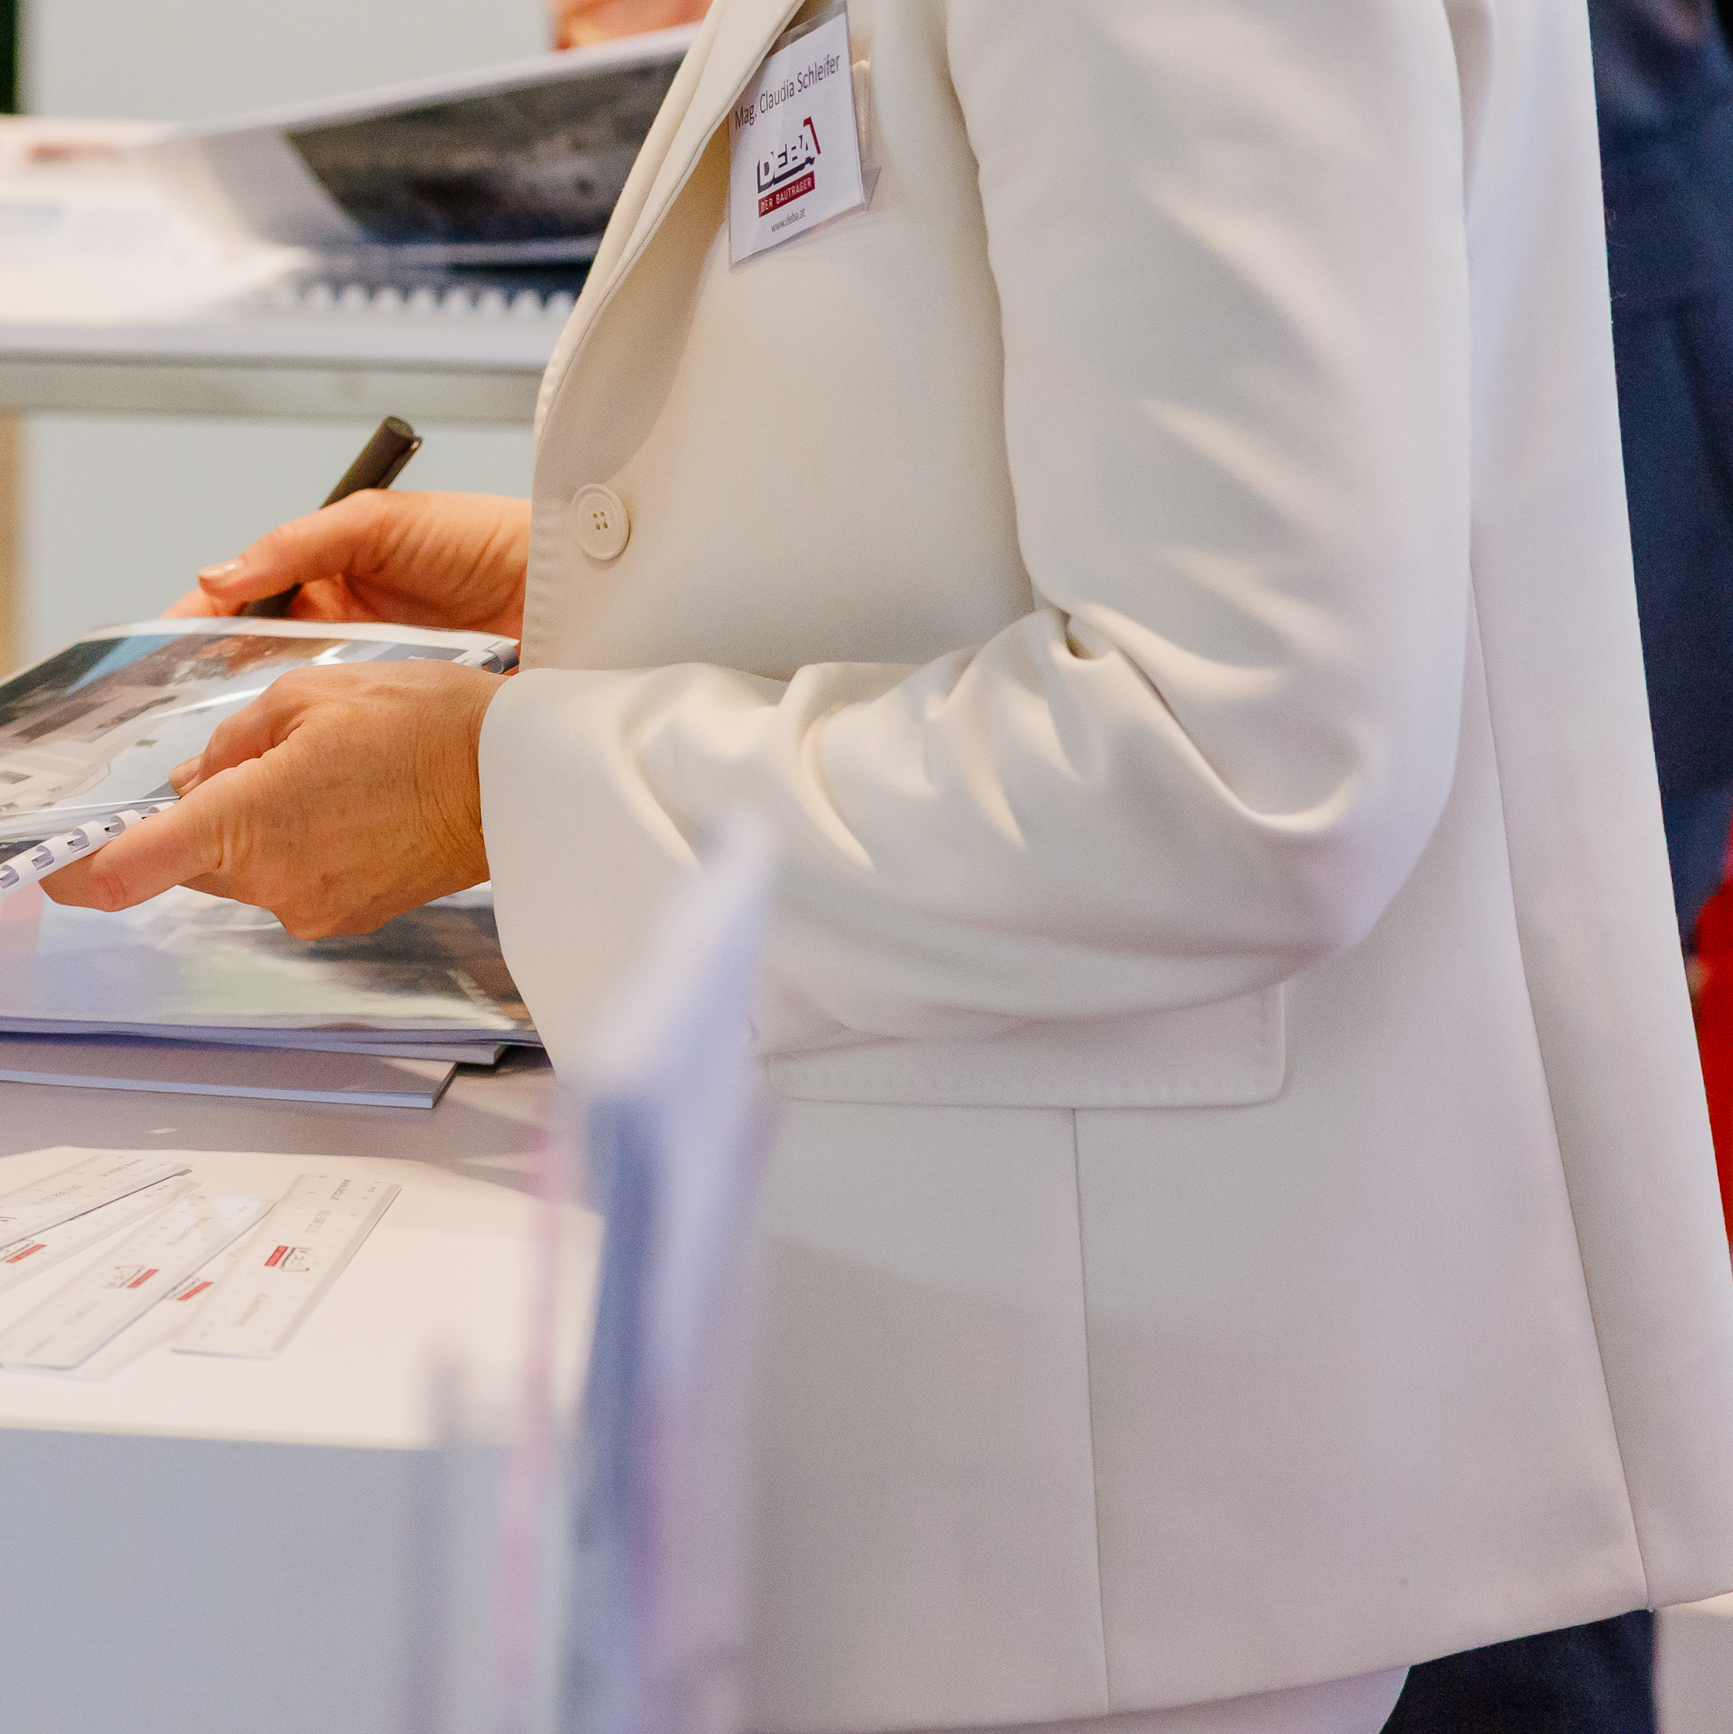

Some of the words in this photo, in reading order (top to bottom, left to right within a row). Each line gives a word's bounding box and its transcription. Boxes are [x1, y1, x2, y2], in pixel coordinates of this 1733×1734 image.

[735, 104, 758, 130] Mag.
[759, 79, 795, 114] Claudia
[796, 53, 840, 93] Schleifer
[761, 197, 774, 213] DER
